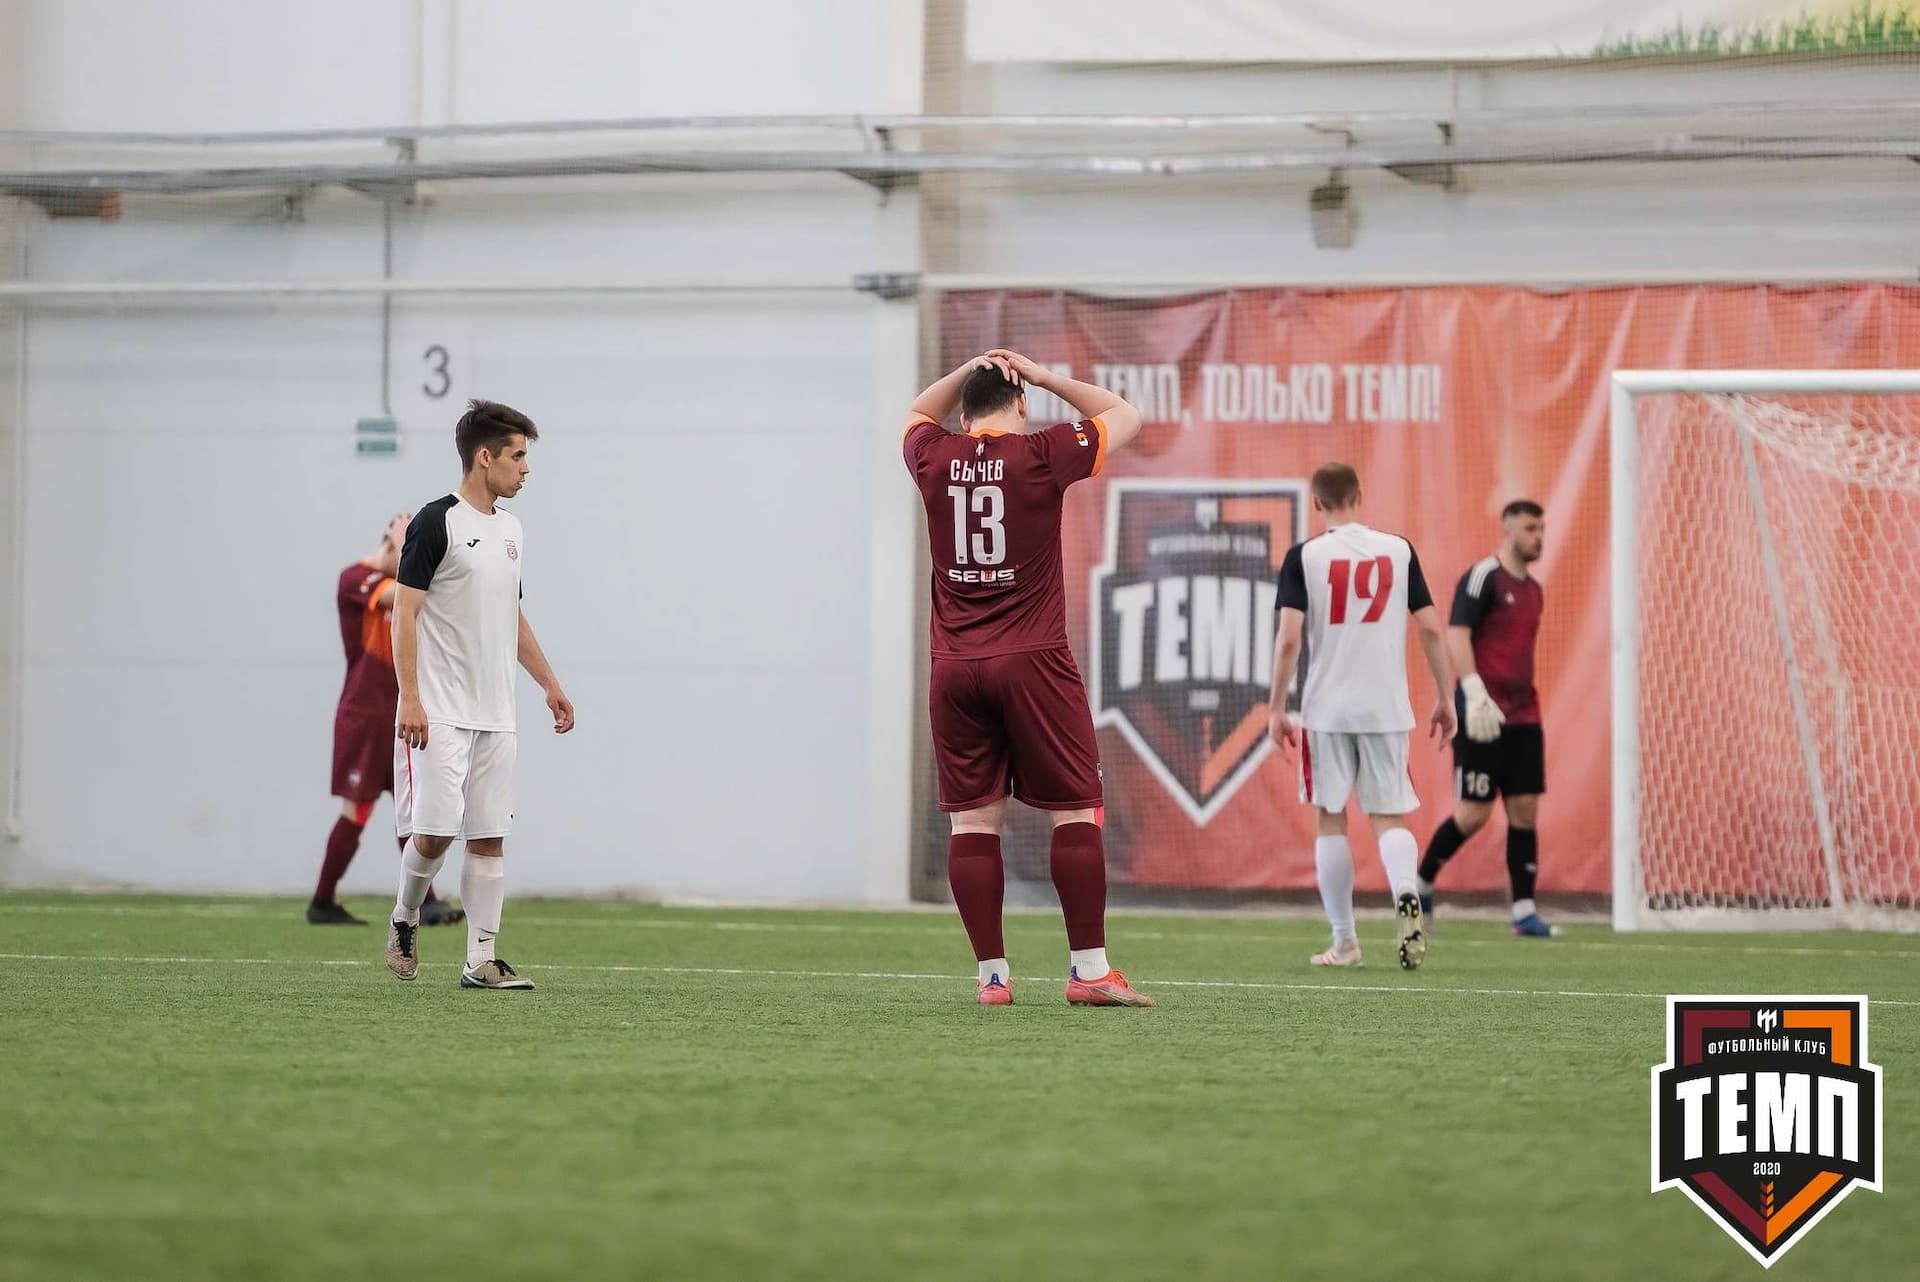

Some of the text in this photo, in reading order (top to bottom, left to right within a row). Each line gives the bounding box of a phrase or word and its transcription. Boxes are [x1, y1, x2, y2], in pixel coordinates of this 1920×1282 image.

[424, 344, 450, 399] 3
[1203, 363, 1333, 423] ТОЛЬКО
[1341, 363, 1441, 423] ТЕМП!
[950, 459, 1004, 482] СЫЧЕВ
[947, 485, 1006, 565] 13
[948, 568, 1015, 583] SEUS
[1328, 555, 1394, 625] 19
[1465, 771, 1490, 796] 16
